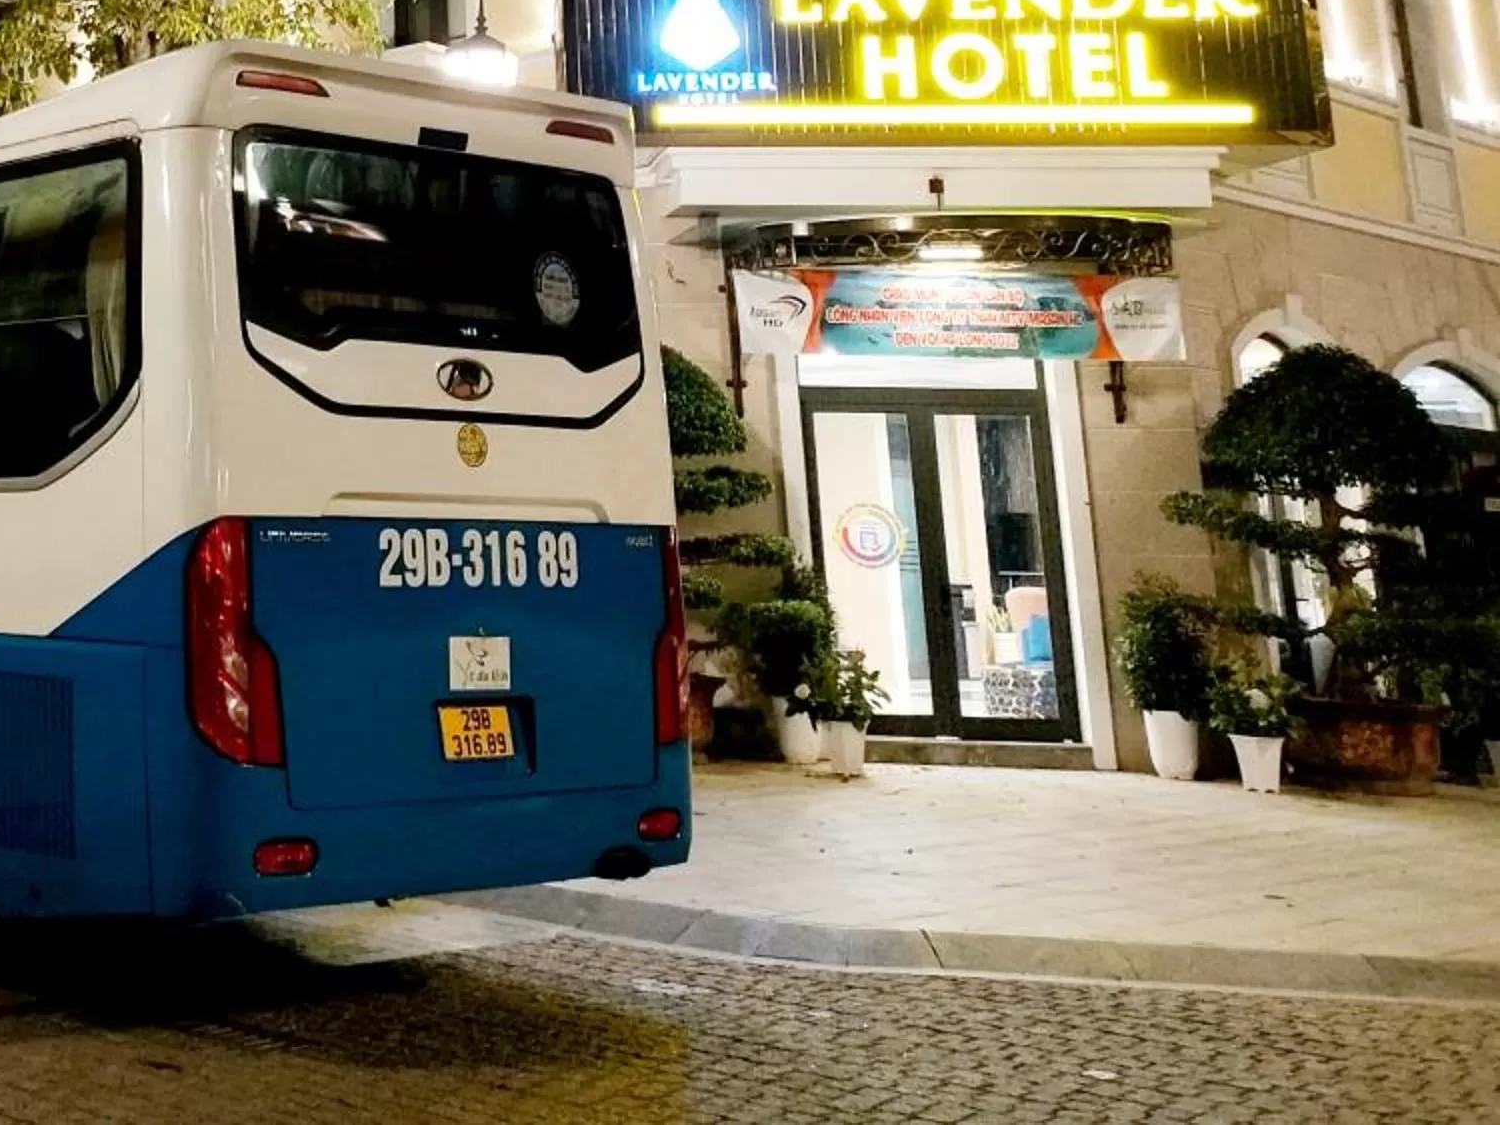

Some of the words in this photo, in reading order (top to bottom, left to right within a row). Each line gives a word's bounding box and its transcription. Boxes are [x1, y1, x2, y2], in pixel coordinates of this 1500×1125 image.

[858, 31, 1169, 101] HOTEL
[636, 71, 777, 92] LAVENDER
[537, 530, 579, 588] 89
[461, 709, 491, 732] 29B
[452, 732, 507, 756] 316.89
